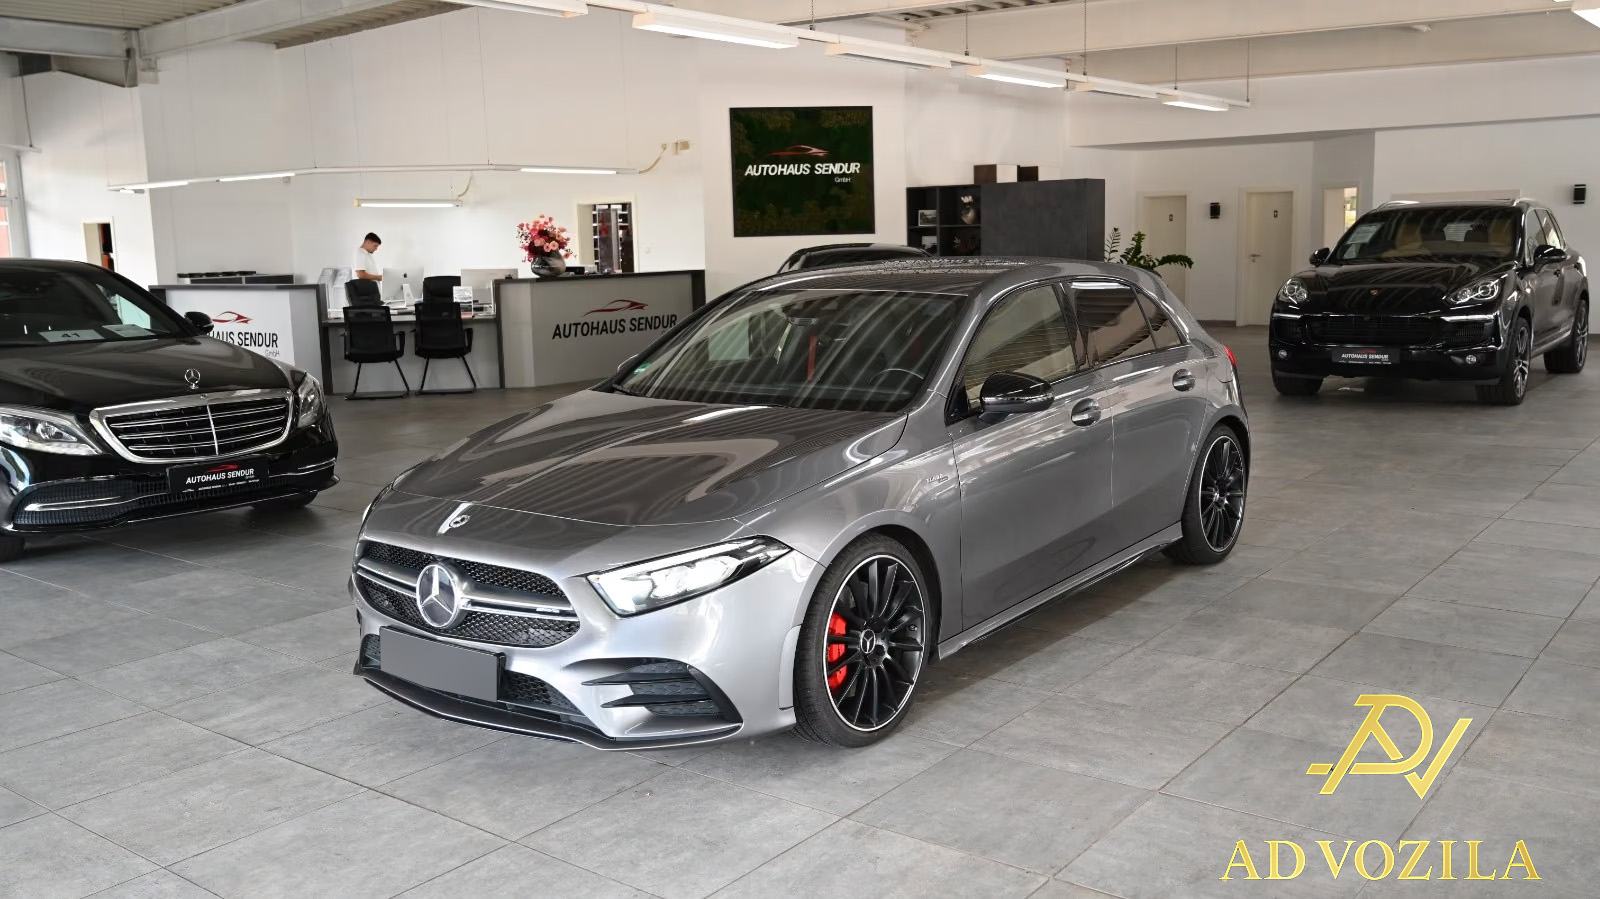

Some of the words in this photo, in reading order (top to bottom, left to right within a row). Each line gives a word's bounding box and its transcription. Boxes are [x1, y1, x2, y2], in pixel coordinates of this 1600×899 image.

[744, 163, 811, 176] AUTOHAUS
[814, 162, 860, 175] SENDUR
[552, 319, 626, 340] AUTOHAUS
[629, 314, 678, 332] SENDUR
[237, 331, 278, 348] SENDUR
[185, 472, 226, 485] AUTOHAUS
[227, 468, 255, 479] SENDUR
